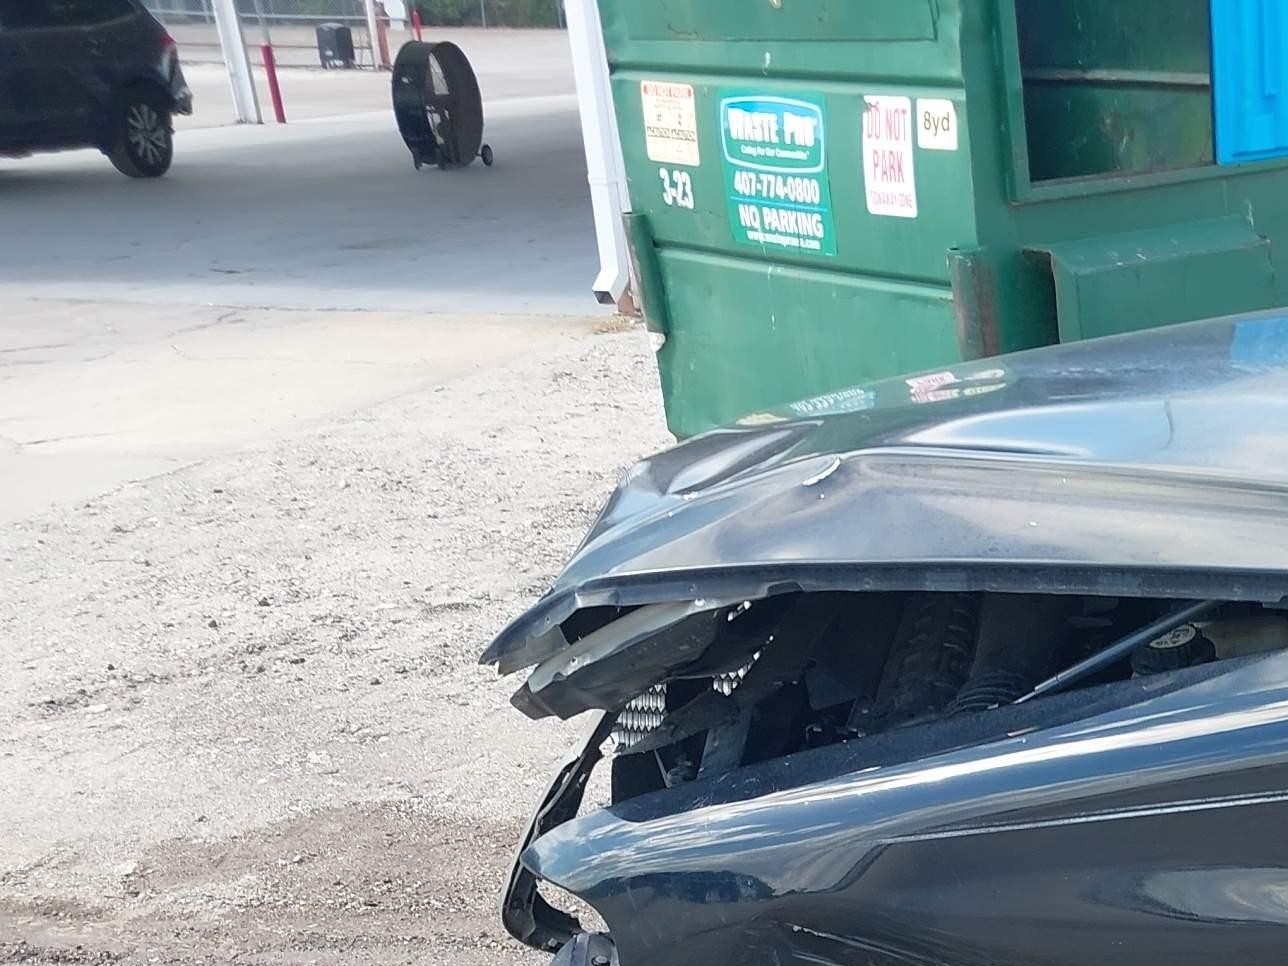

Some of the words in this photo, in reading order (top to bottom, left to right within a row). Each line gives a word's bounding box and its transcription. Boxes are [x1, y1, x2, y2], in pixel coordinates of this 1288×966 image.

[885, 107, 907, 141] NOT
[924, 111, 950, 136] 8yd
[873, 150, 904, 183] PARK
[659, 167, 694, 209] 3-23
[734, 171, 820, 204] 407-774-0800
[738, 204, 760, 229] NO
[762, 206, 824, 238] PARKING
